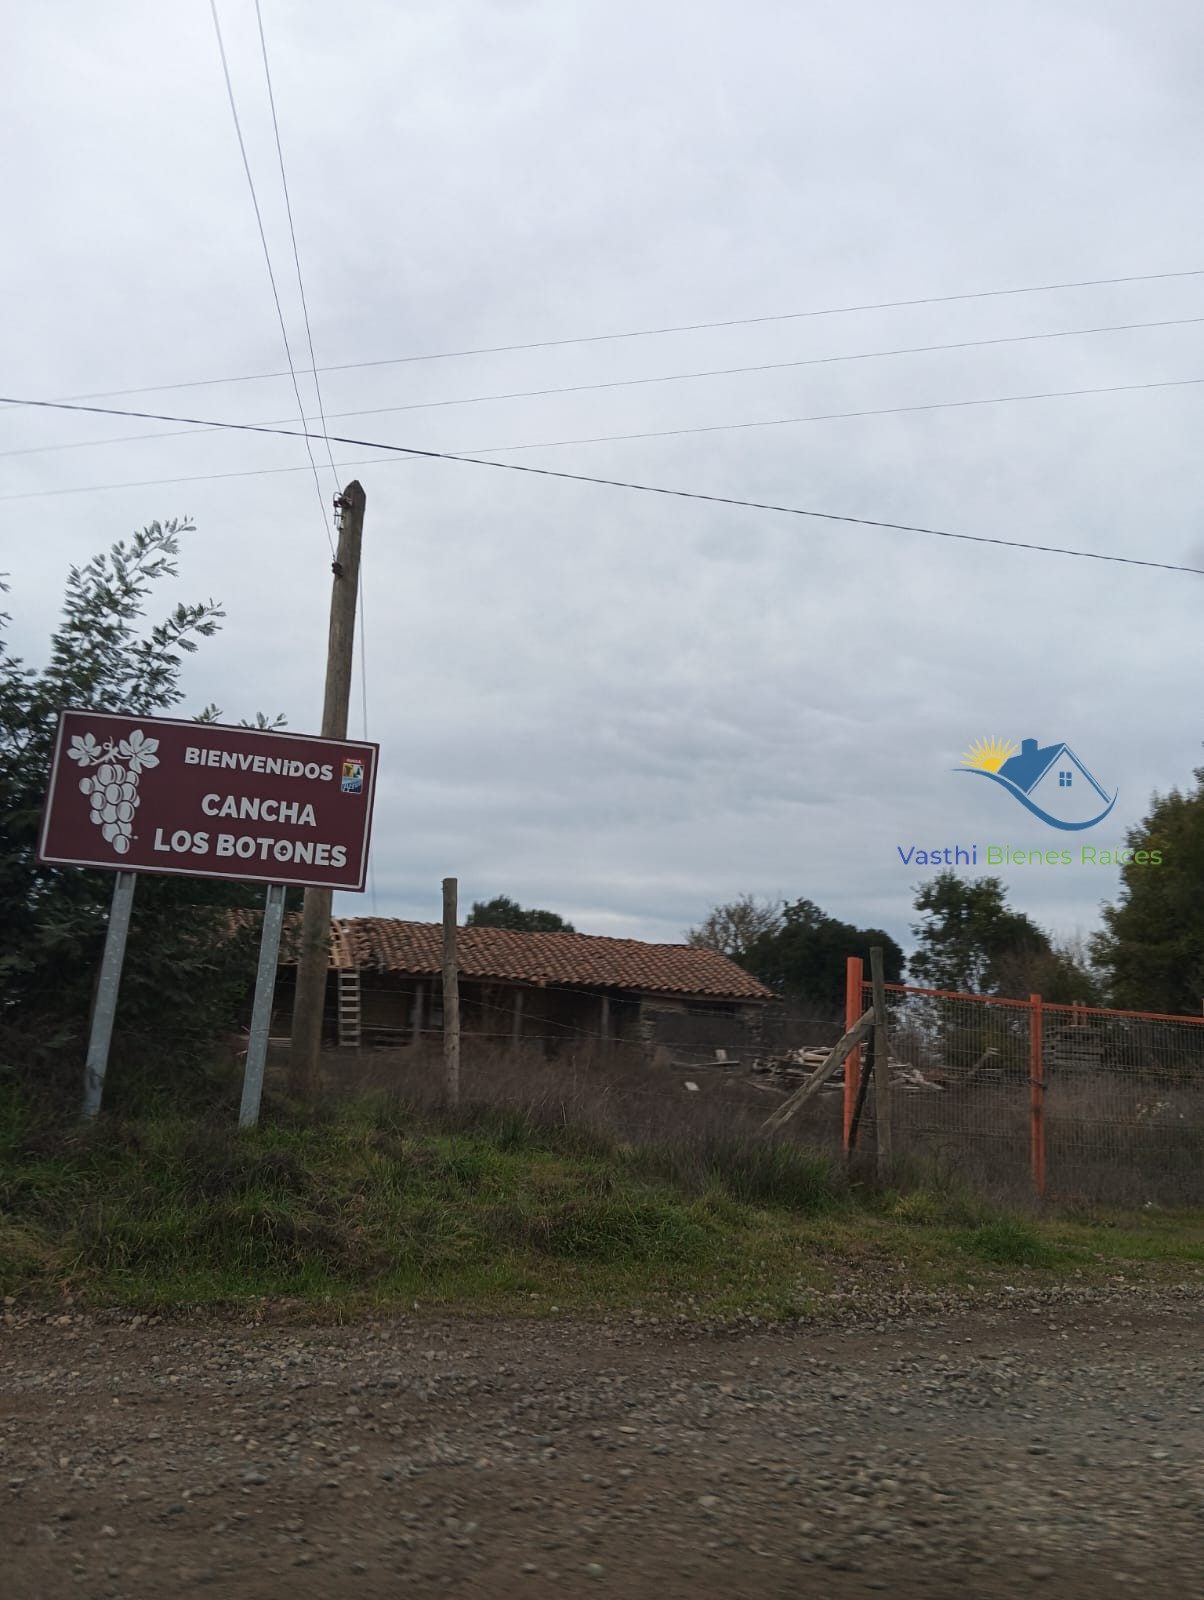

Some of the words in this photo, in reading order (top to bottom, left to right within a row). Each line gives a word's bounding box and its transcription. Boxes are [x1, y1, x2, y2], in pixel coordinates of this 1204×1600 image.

[185, 747, 334, 781] BIENVENIDOS
[202, 794, 316, 827] CANCHA
[154, 828, 209, 854] LOS
[216, 834, 347, 868] BOTONES
